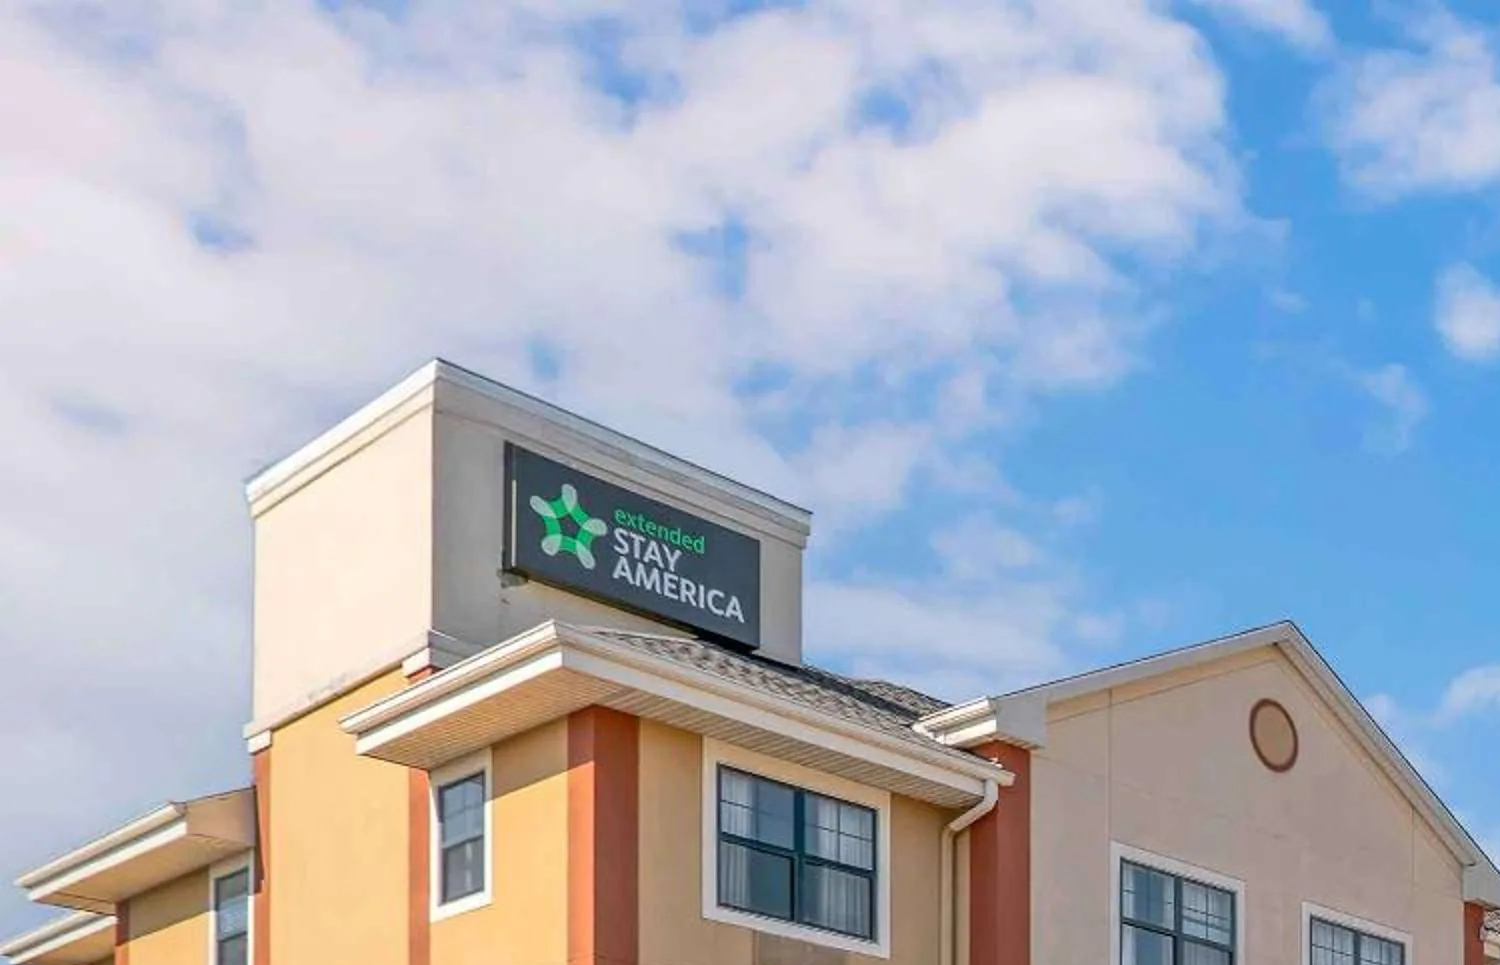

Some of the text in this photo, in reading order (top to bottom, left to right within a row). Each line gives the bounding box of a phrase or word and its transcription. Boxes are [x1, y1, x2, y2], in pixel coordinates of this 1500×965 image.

[613, 527, 682, 573] STAY
[615, 509, 705, 554] extended
[612, 556, 745, 623] AMERICA
